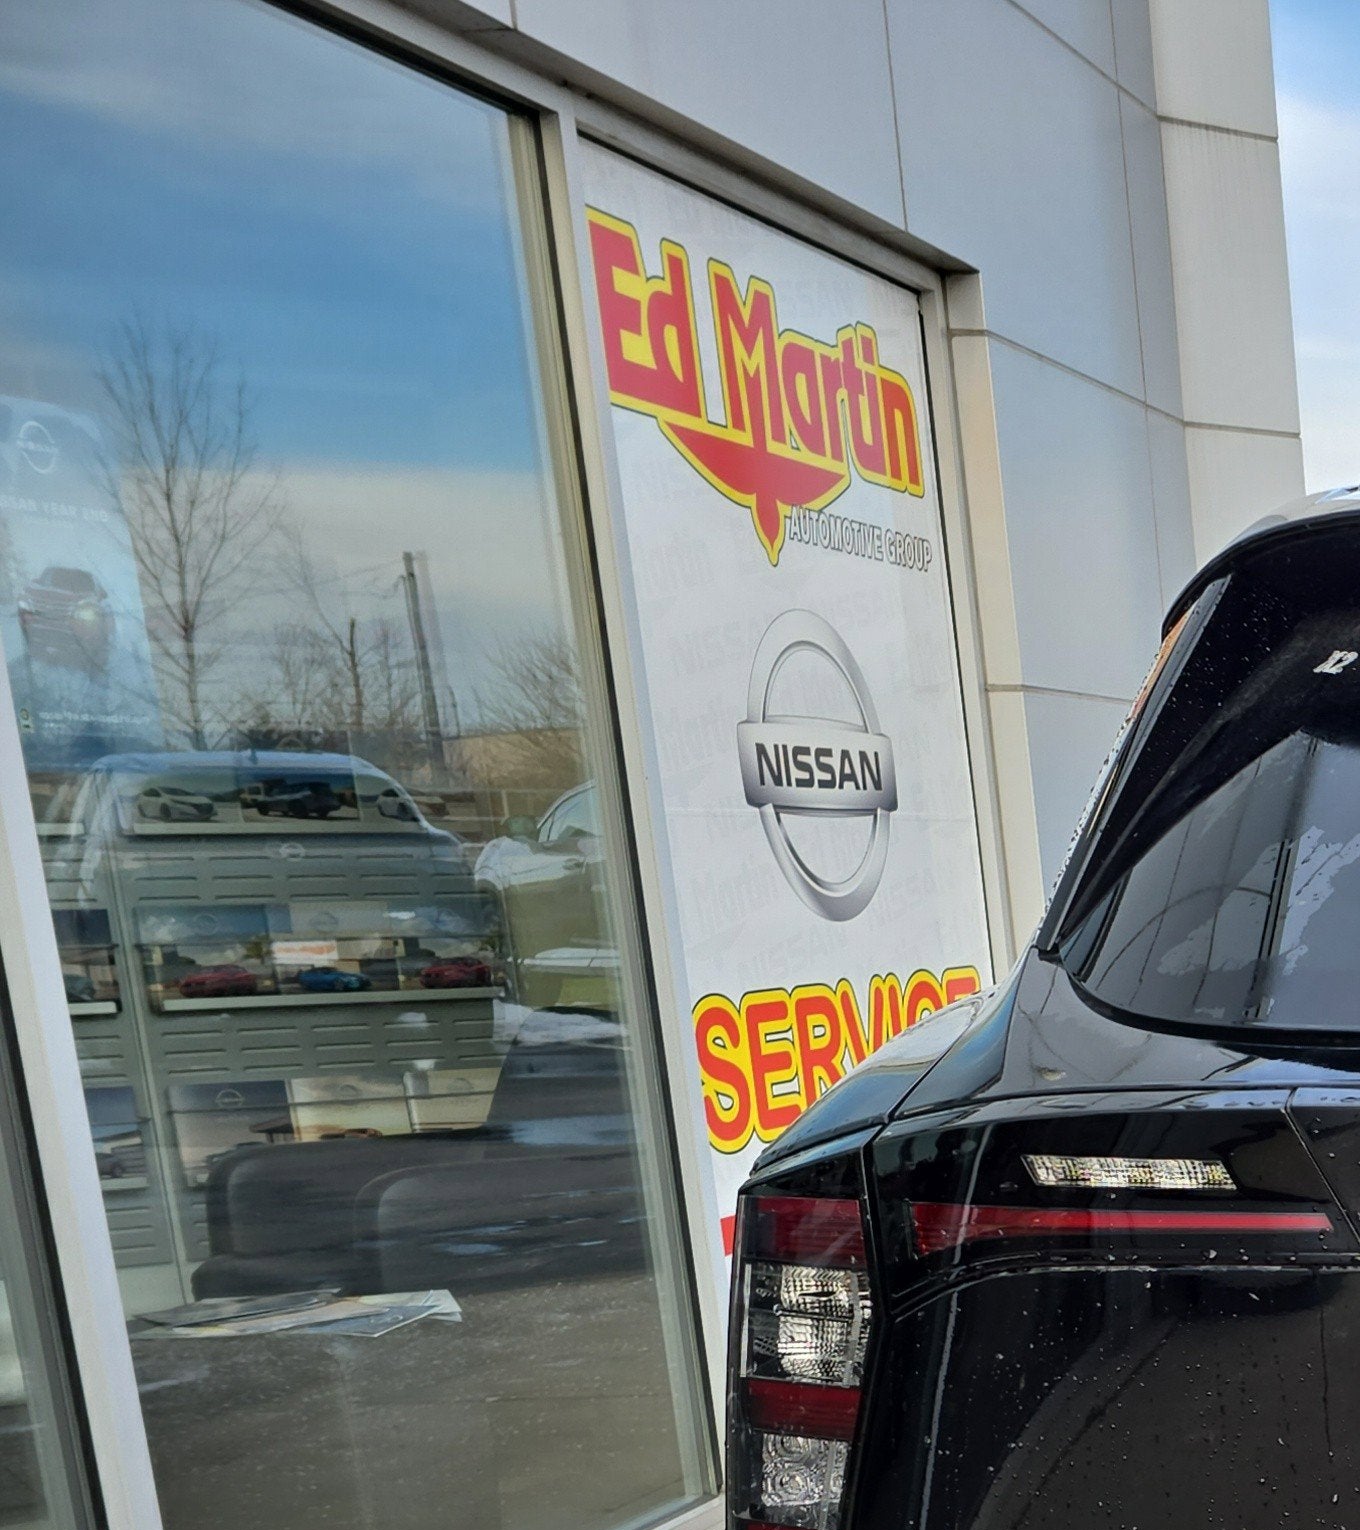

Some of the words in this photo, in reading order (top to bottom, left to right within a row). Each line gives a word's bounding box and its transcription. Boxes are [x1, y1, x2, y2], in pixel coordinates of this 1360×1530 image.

[586, 205, 705, 426] Ed
[708, 257, 924, 498] Martin
[789, 504, 884, 562] AUTOMOTIVE
[884, 528, 932, 573] GROUP
[755, 743, 883, 791] NISSAN
[693, 966, 979, 1153] SERV
